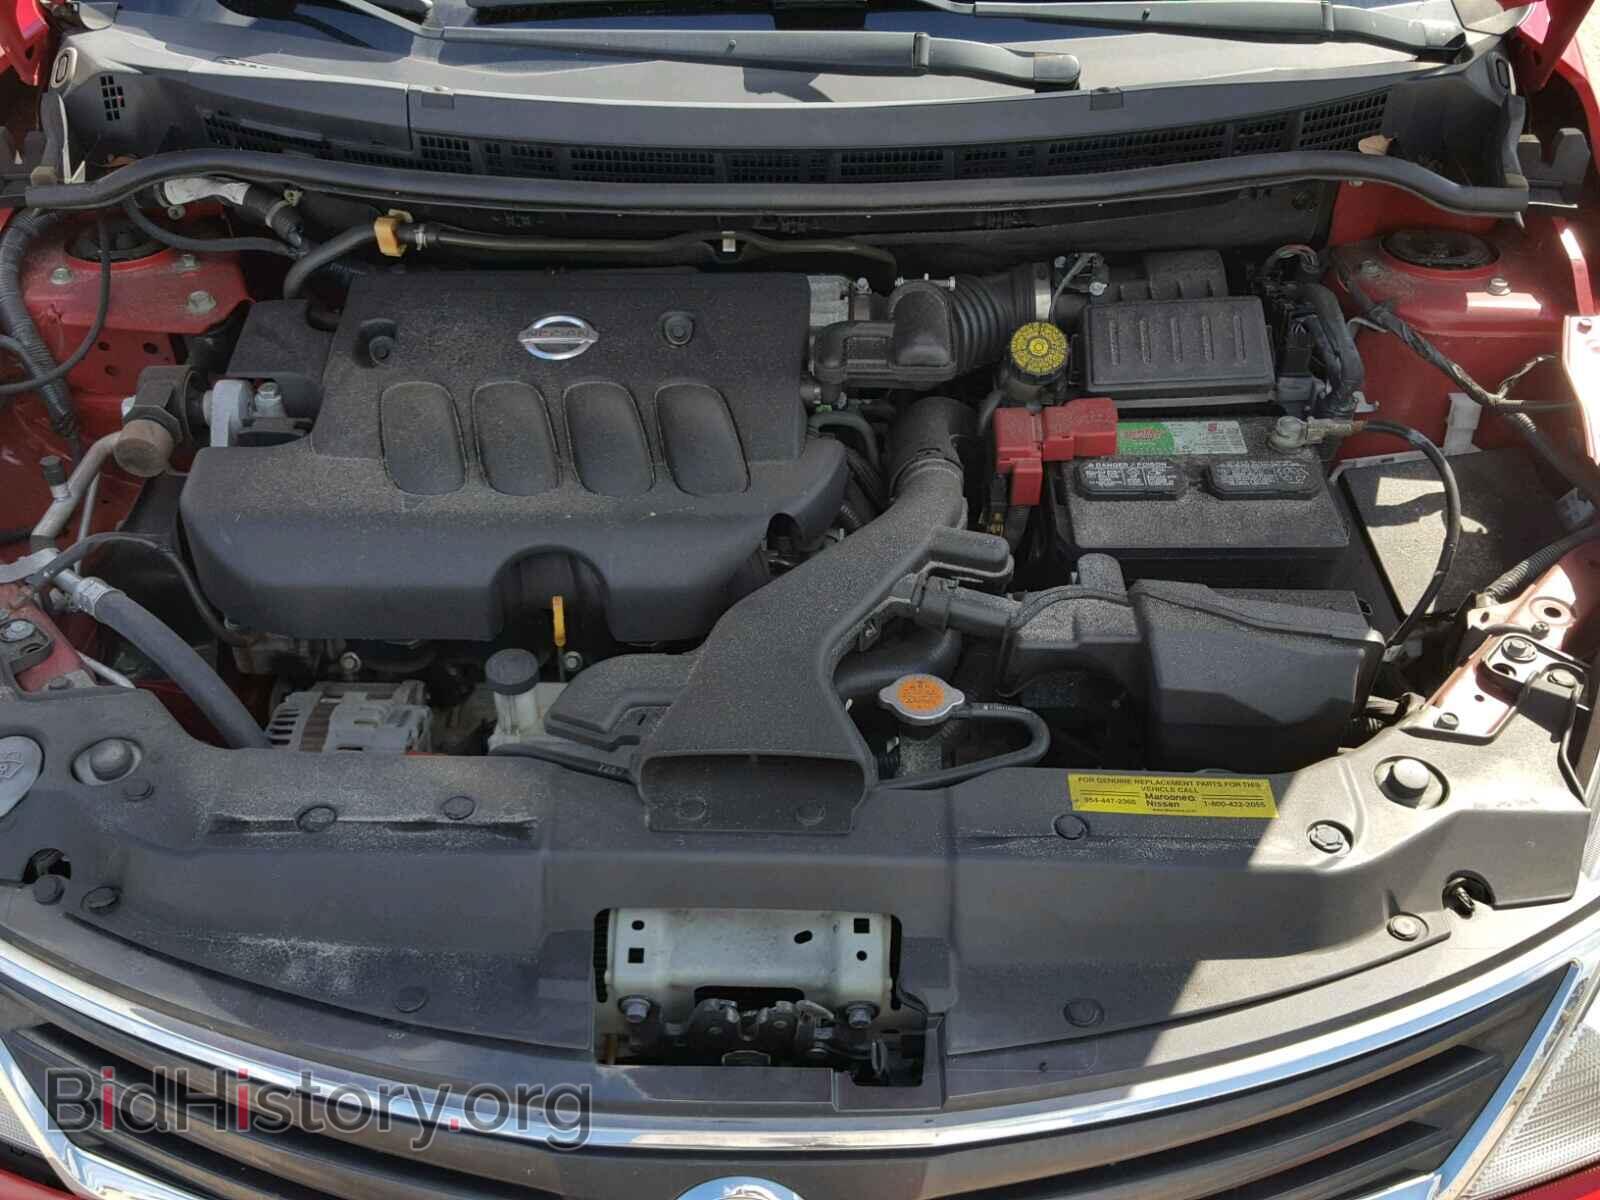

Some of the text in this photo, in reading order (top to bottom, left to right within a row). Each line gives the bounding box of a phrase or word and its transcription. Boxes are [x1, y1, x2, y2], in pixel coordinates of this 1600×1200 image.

[1078, 776, 1094, 784] FOR
[1141, 785, 1176, 793] VEHICLE
[1145, 800, 1181, 809] Nissan
